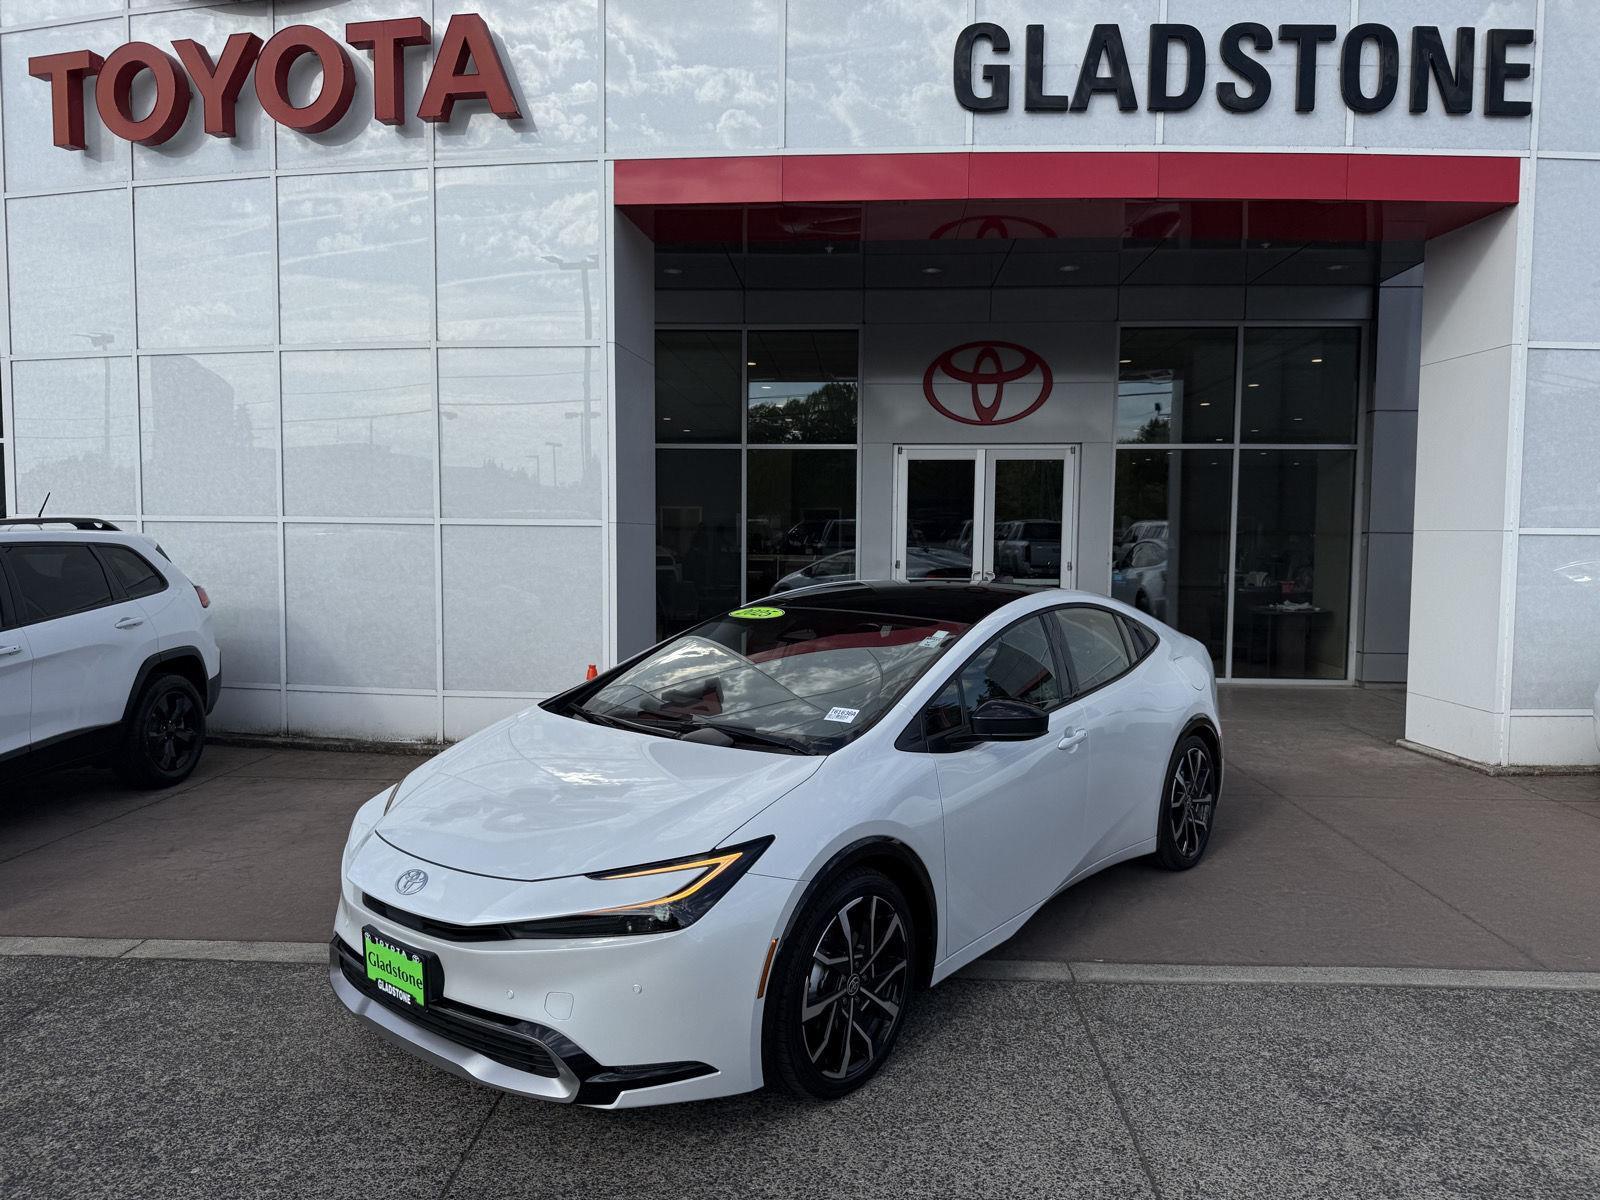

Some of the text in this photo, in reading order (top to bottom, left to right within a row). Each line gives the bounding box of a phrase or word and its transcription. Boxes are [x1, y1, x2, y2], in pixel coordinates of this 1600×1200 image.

[28, 13, 523, 151] TOYOTA
[952, 22, 1535, 117] GLADSTONE
[374, 937, 408, 957] TOYOTA
[368, 951, 424, 990] Gladstone
[377, 979, 412, 1005] GLADSTONE
